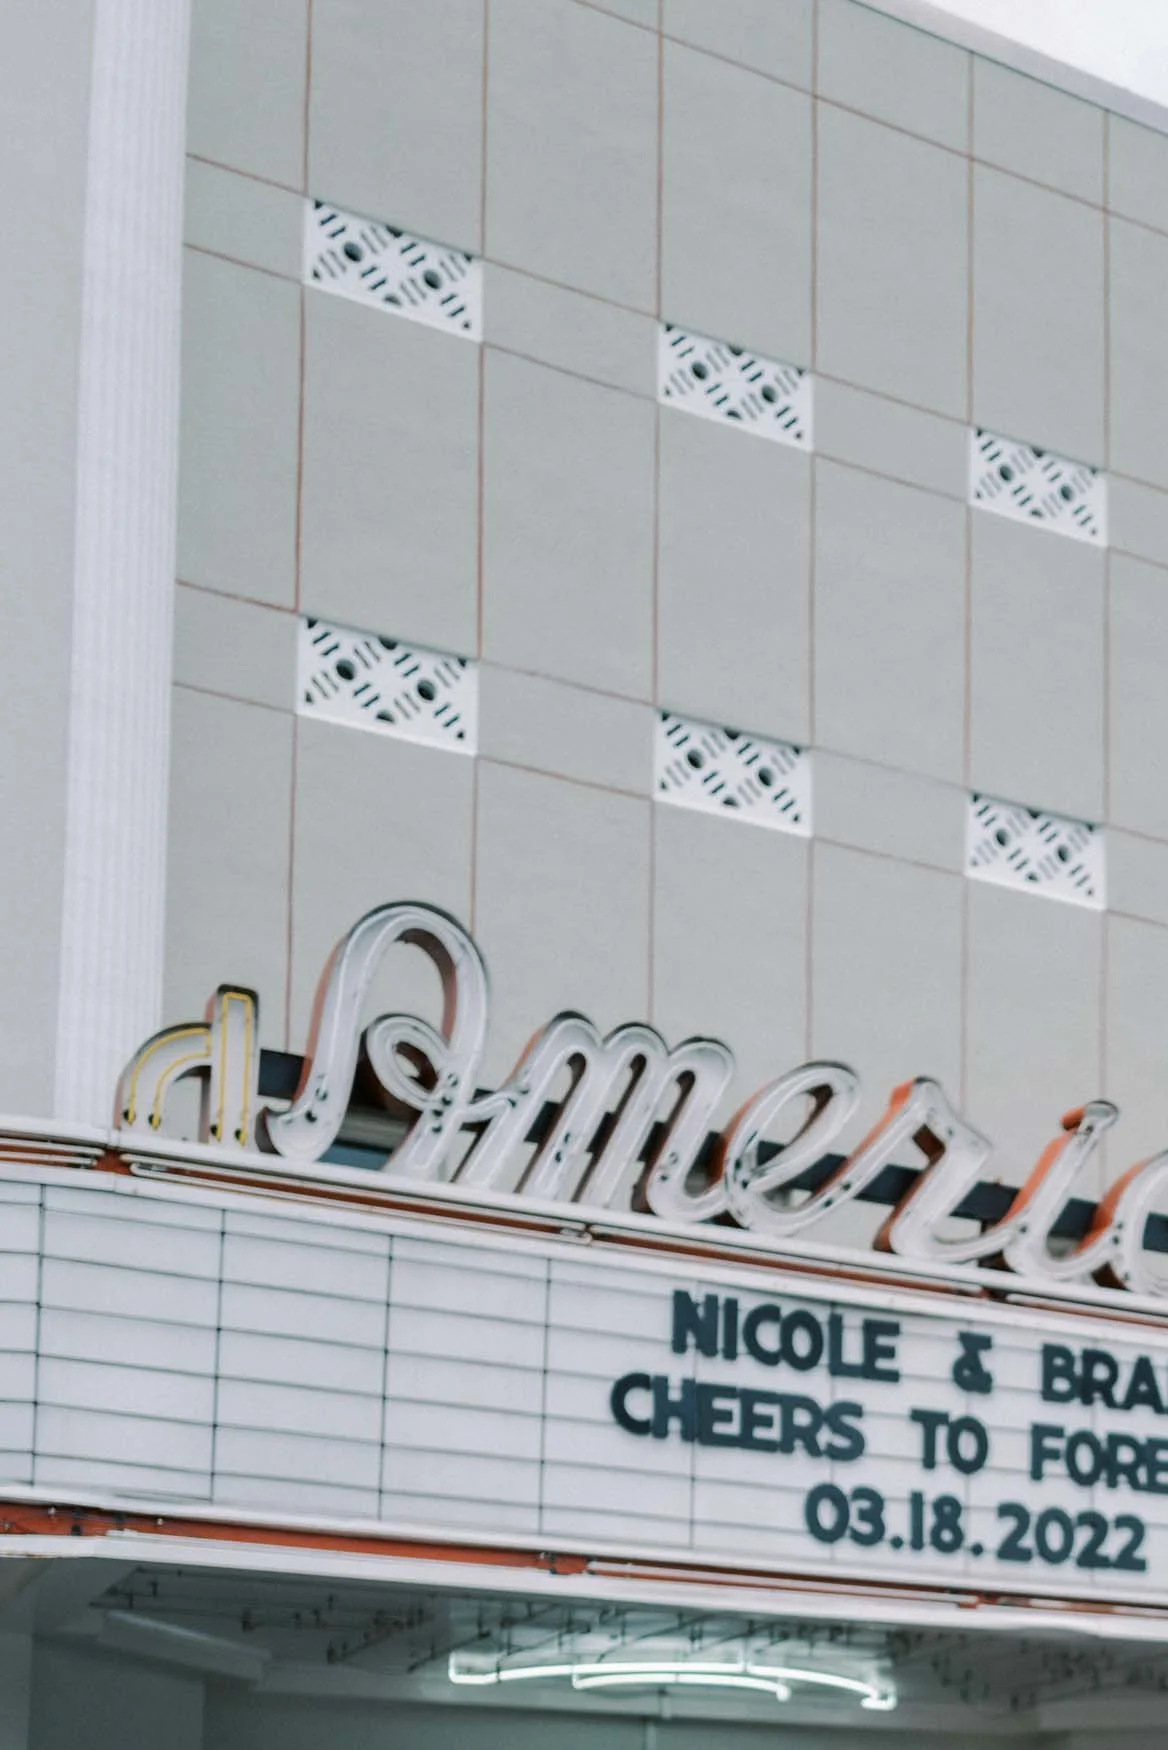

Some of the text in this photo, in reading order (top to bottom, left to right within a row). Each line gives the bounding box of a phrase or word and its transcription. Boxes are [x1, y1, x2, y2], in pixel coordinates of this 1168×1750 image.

[670, 1288, 901, 1383] NICOLE
[951, 1330, 994, 1396] &
[609, 1371, 866, 1463] CHEERS
[909, 1408, 990, 1476] TO
[804, 1482, 1148, 1572] 03.18.2022
